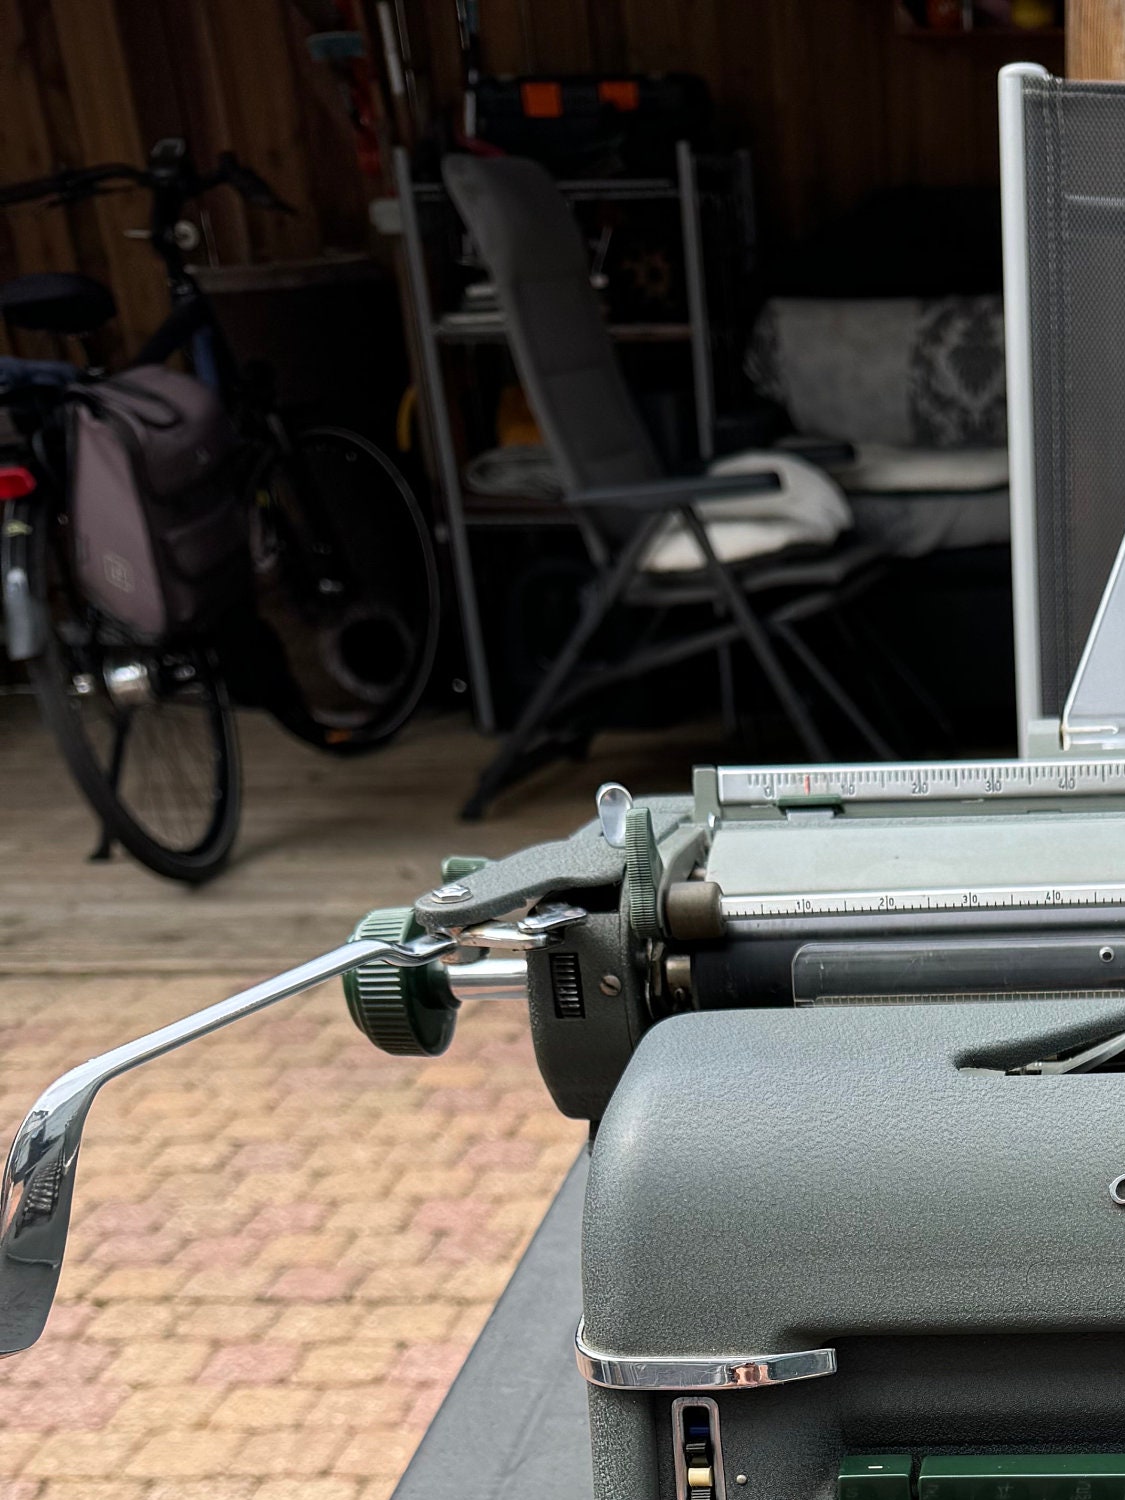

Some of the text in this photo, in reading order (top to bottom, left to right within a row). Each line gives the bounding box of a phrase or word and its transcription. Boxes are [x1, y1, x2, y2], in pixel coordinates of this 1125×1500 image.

[796, 900, 812, 911] 10
[879, 897, 895, 908] 20
[963, 894, 978, 905] 30
[1046, 891, 1061, 902] 40
